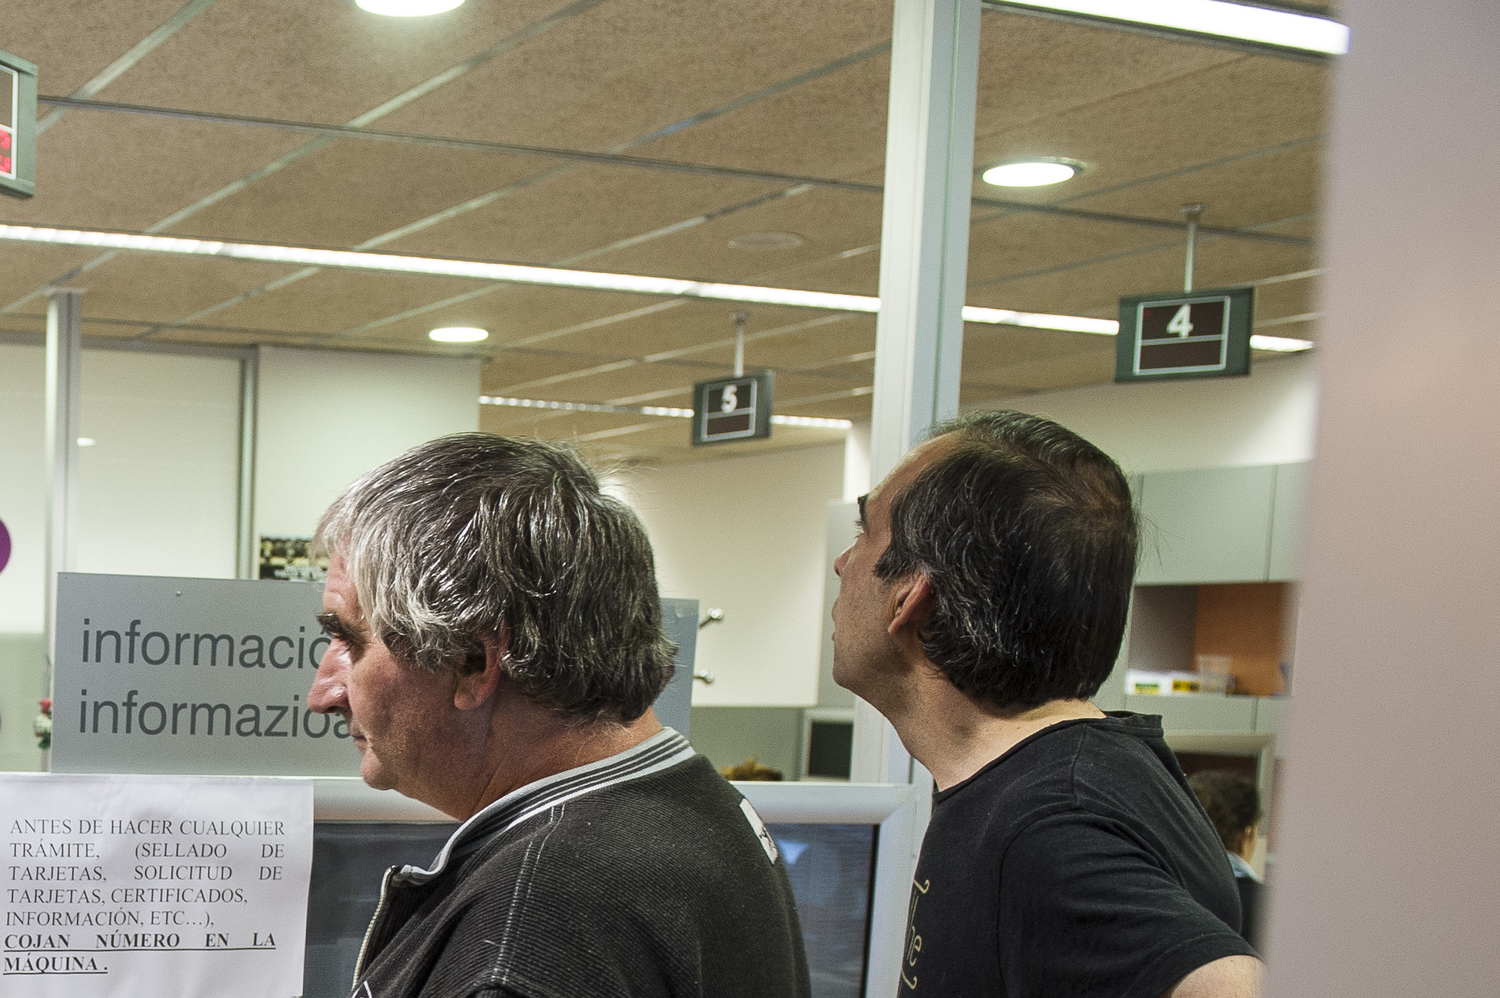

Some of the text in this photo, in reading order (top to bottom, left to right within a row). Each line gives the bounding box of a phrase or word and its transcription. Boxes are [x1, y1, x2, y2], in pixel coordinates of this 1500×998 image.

[1166, 303, 1194, 338] 4
[721, 384, 738, 413] 5
[11, 819, 284, 838] ANTES DE HACER CUALQUIER
[10, 839, 284, 860] TRÁMITE, (SELLADO DE
[9, 865, 282, 881] TARJETAS, SOLICITUD DE
[7, 888, 247, 903] TARJETAS, CERTIFICADOS,
[7, 908, 143, 926] INFORMACIÓN,
[5, 929, 275, 948] COJAN NÚMERO EN LA
